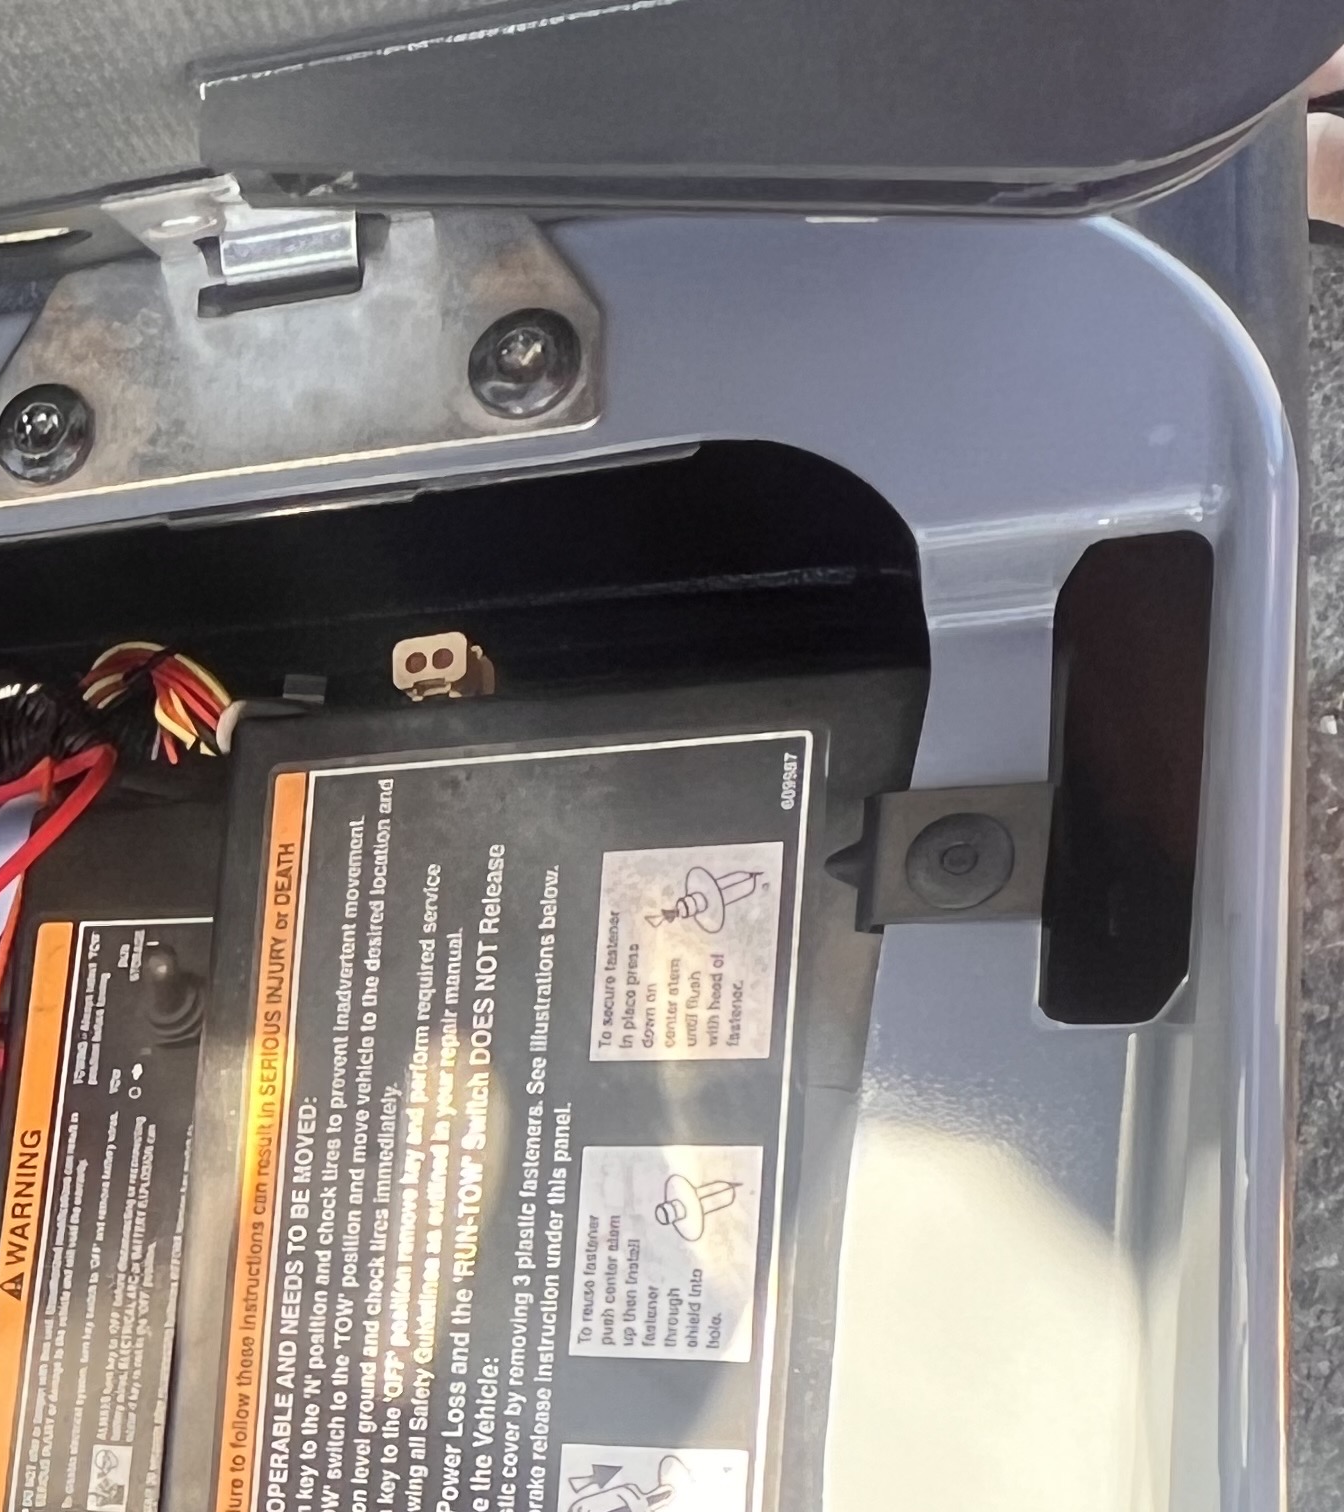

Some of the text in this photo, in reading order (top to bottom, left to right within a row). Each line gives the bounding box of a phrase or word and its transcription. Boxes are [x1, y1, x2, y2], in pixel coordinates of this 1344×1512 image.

[376, 777, 394, 814] and
[272, 841, 295, 906] DEATH
[367, 817, 391, 895] location
[421, 862, 441, 934] service
[477, 843, 506, 934] Release
[273, 910, 289, 931] or
[362, 899, 385, 972] desired
[264, 935, 287, 1005] INJURY
[331, 922, 357, 1032] inadvertent
[360, 974, 380, 1007] the
[415, 937, 437, 1021] required
[473, 939, 498, 992] NOT
[528, 932, 556, 1052] illustrations
[358, 1010, 377, 1032] to
[432, 1007, 461, 1068] repair
[466, 996, 495, 1067] DOES
[259, 1007, 283, 1096] SERIOUS
[329, 1034, 349, 1109] prevent
[354, 1035, 375, 1106] vehicle
[404, 1024, 433, 1108] perform
[524, 1055, 547, 1095] See
[256, 1100, 276, 1120] in
[434, 1068, 457, 1118] your
[459, 1071, 490, 1151] Switch
[255, 1122, 274, 1178] result
[324, 1113, 343, 1134] to
[351, 1108, 370, 1163] move
[404, 1104, 426, 1146] and
[428, 1119, 451, 1141] in
[320, 1137, 342, 1182] tires
[347, 1167, 366, 1205] and
[397, 1147, 427, 1185] key
[424, 1143, 450, 1227] outlined
[545, 1166, 567, 1205] this
[3, 1128, 42, 1266] WARNING
[251, 1180, 268, 1216] can
[289, 1187, 310, 1219] BE
[315, 1185, 338, 1245] chock
[396, 1186, 419, 1262] remove
[285, 1224, 308, 1255] TO
[340, 1209, 362, 1288] position
[368, 1207, 390, 1251] tires
[424, 1227, 443, 1255] as
[513, 1202, 537, 1269] plastic
[543, 1209, 564, 1269] under
[237, 1220, 265, 1331] instructions
[313, 1248, 332, 1286] and
[362, 1254, 386, 1316] chock
[511, 1273, 531, 1287] 3
[278, 1258, 304, 1335] NEEDS
[387, 1264, 412, 1347] position
[449, 1287, 474, 1325] the
[306, 1289, 328, 1370] position
[361, 1319, 381, 1358] and
[447, 1331, 470, 1375] and
[507, 1291, 534, 1386] removing
[532, 1273, 560, 1383] instruction
[234, 1334, 255, 1388] these
[274, 1339, 297, 1389] AND
[329, 1353, 350, 1386] the
[227, 1391, 251, 1449] follow
[299, 1402, 320, 1435] the
[328, 1390, 348, 1411] to
[357, 1359, 383, 1433] ground
[380, 1406, 402, 1439] the
[407, 1366, 435, 1431] Safety
[439, 1380, 467, 1437] Loss
[502, 1390, 528, 1416] by
[297, 1439, 318, 1460] to
[324, 1415, 346, 1480] switch
[407, 1435, 426, 1460] all
[500, 1420, 520, 1478] cover
[528, 1386, 552, 1461] release
[228, 1453, 246, 1473] to
[349, 1437, 371, 1484] level
[379, 1443, 399, 1464] to
[468, 1453, 493, 1491] the
[294, 1463, 320, 1500] key
[375, 1468, 401, 1505] key
